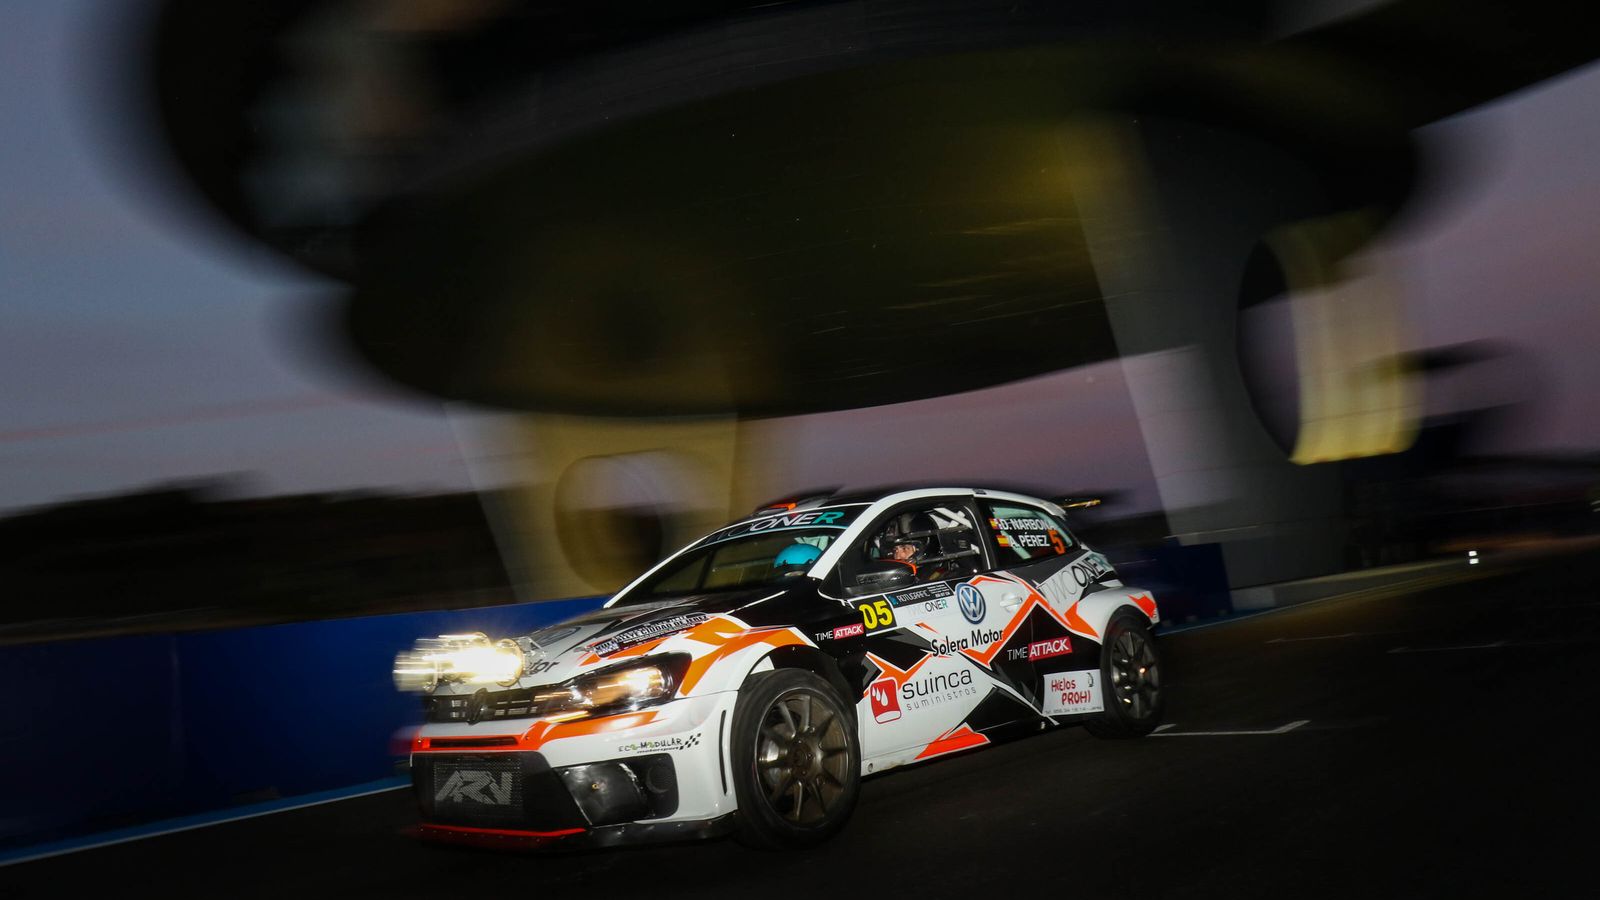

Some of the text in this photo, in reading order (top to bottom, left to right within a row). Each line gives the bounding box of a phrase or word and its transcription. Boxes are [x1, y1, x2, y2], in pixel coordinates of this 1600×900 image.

[1019, 531, 1051, 547] PÉREZ
[1048, 529, 1066, 555] 5
[859, 600, 893, 630] 05
[815, 624, 863, 642] TIME ATTACK
[931, 628, 1004, 657] Solera Motor
[1007, 638, 1069, 661] TIME ATTACK
[902, 668, 973, 700] suinca
[906, 686, 977, 711] suministros
